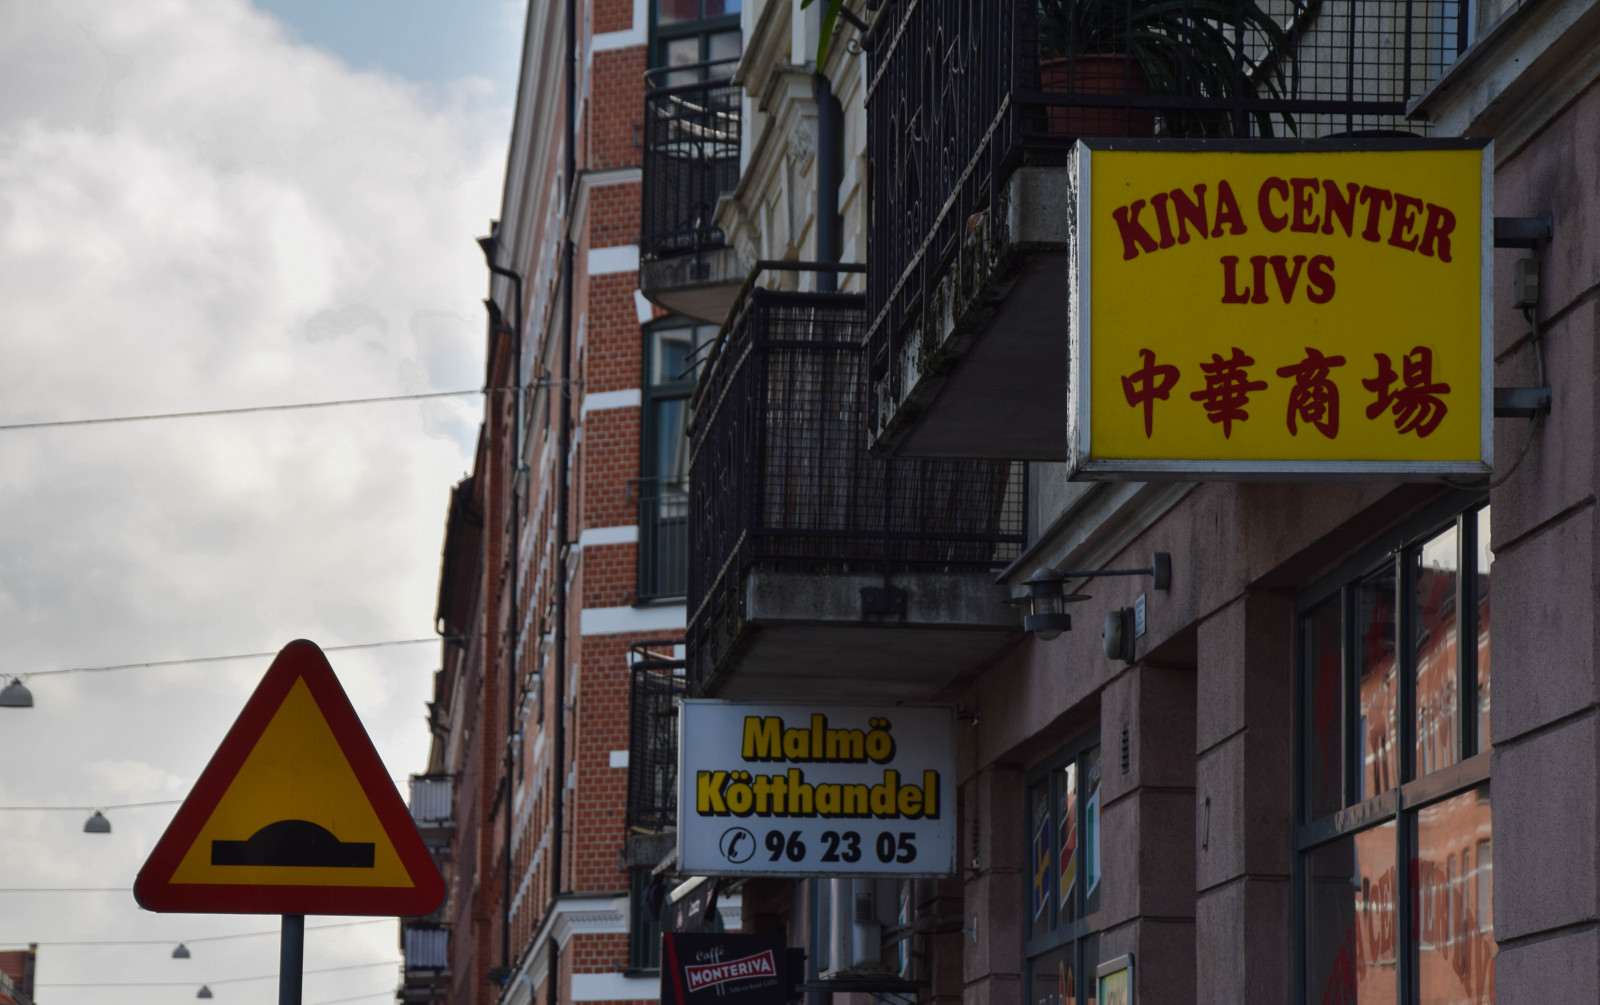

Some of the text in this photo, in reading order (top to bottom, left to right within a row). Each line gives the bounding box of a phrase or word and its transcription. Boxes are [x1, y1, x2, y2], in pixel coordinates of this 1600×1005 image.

[1111, 176, 1457, 264] KINA CENTER
[1219, 254, 1336, 305] LIVS
[1120, 345, 1451, 440] 中華商場
[741, 712, 896, 764] Malmö
[696, 768, 941, 820] Kötthandel
[764, 829, 918, 865] 96 23 05
[690, 957, 771, 987] MONTERIVA
